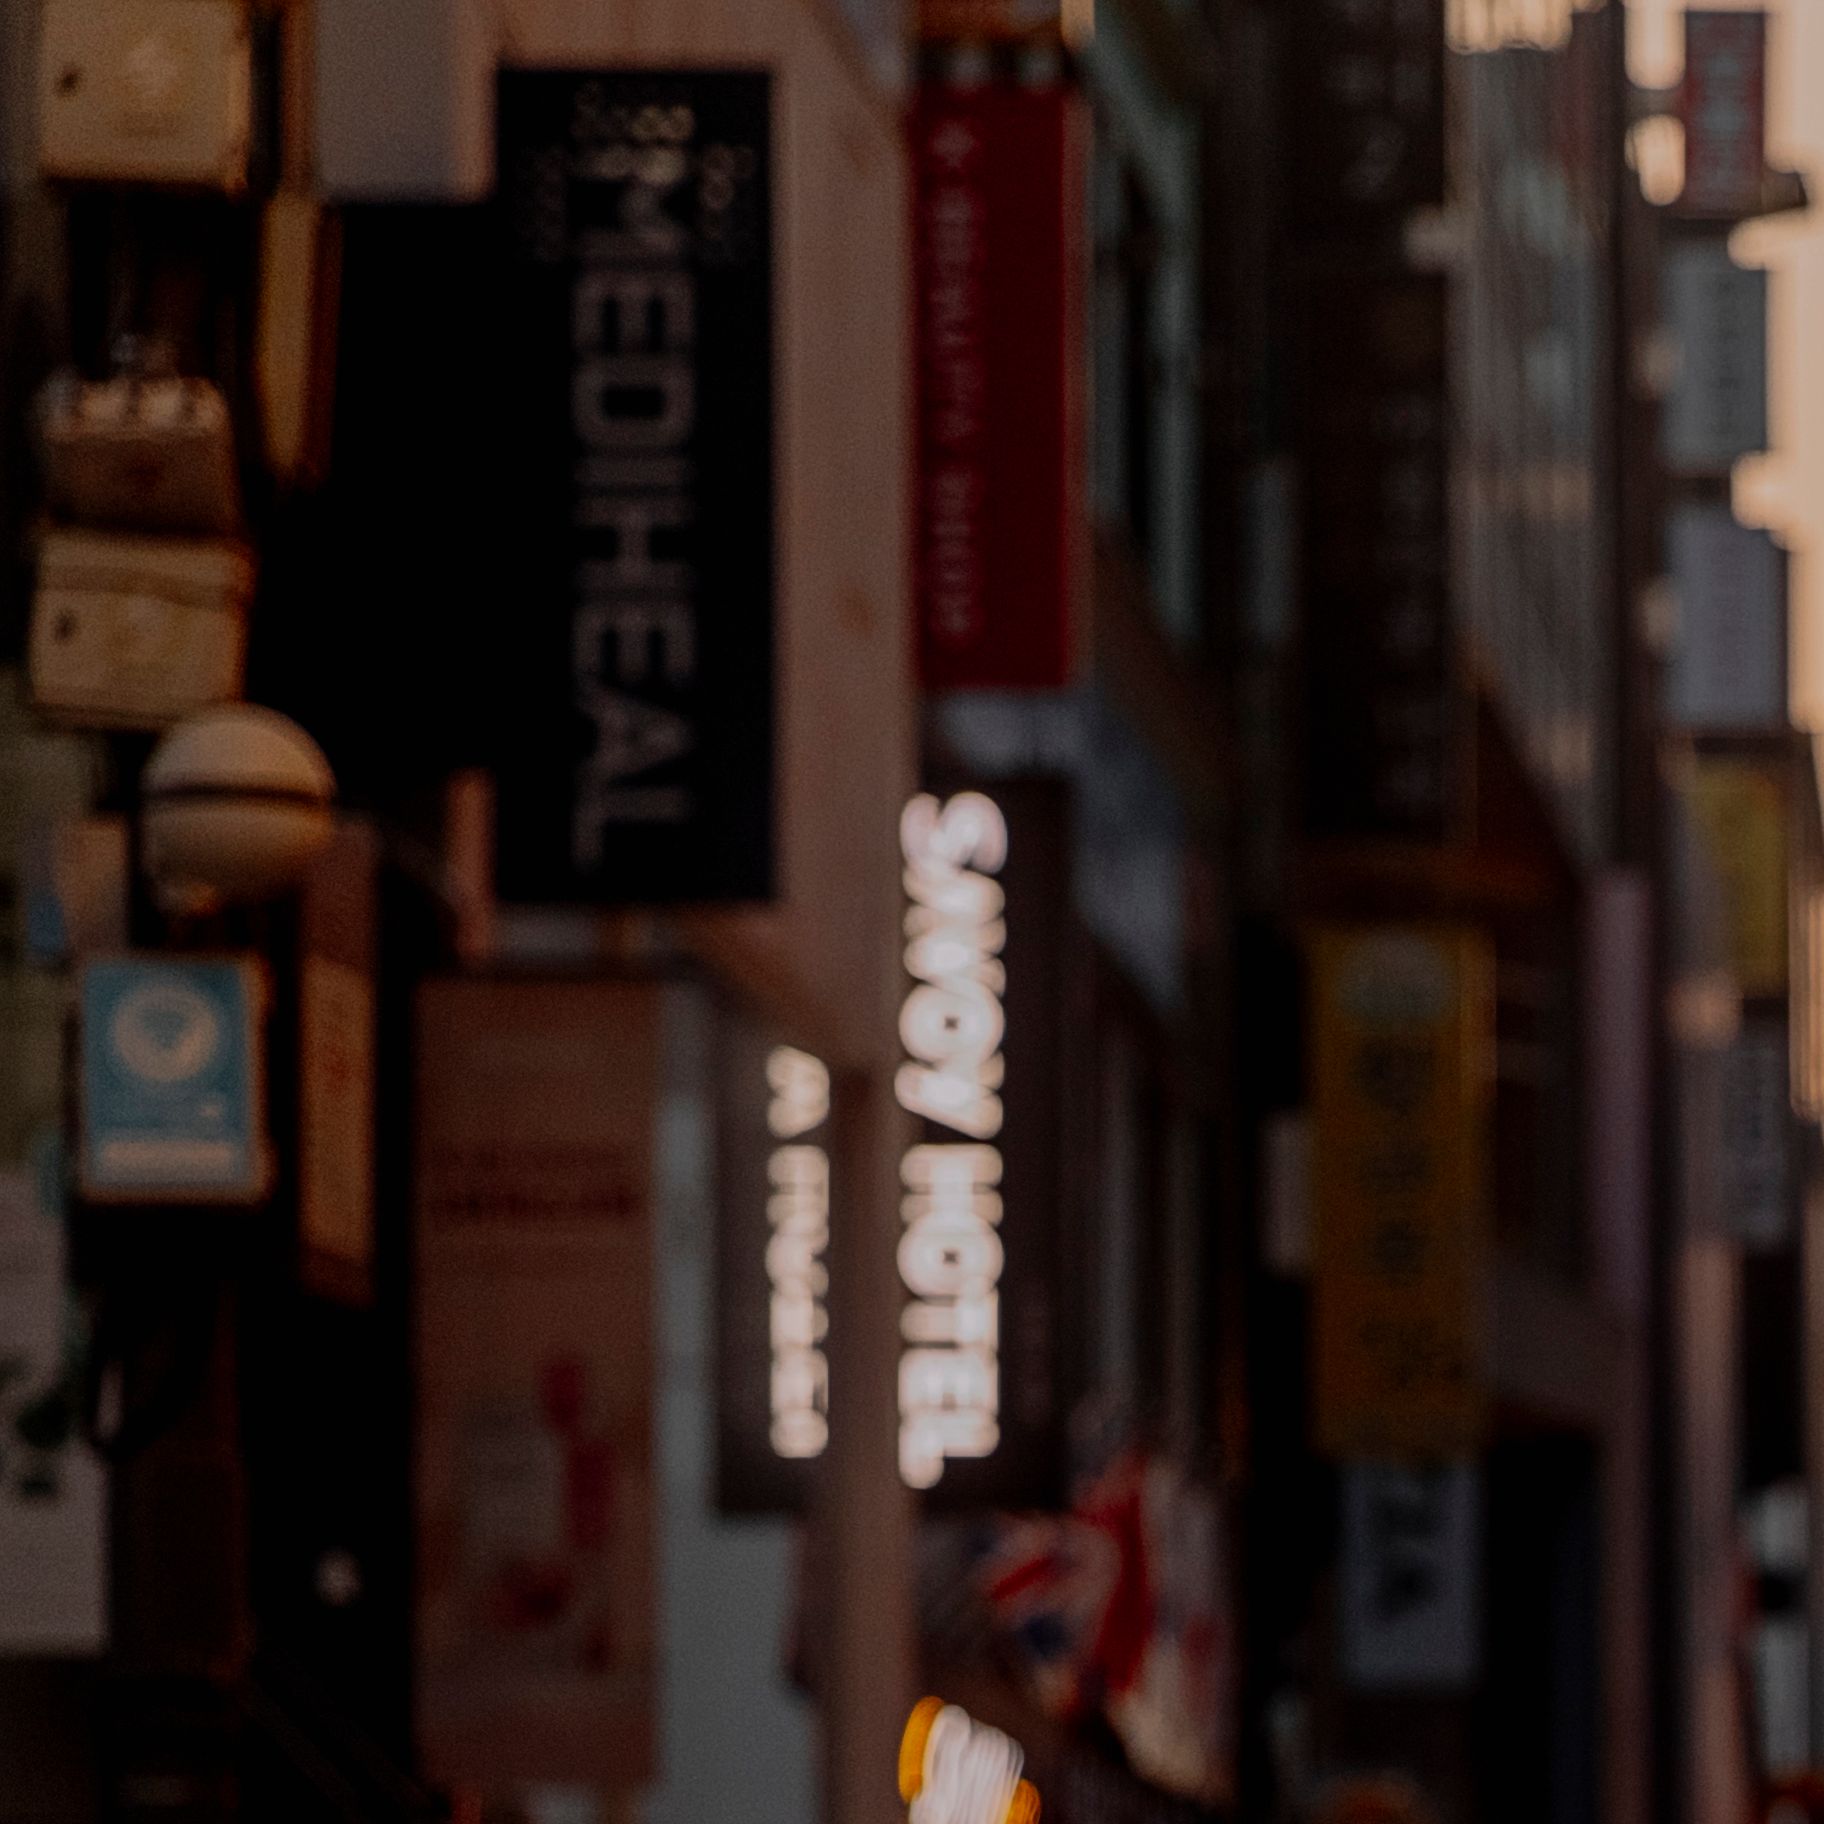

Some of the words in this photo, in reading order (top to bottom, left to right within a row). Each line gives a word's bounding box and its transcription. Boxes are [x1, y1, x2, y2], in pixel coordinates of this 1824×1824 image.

[567, 146, 703, 876] MEDIHEAL
[895, 790, 1009, 1139] SAVOY
[896, 1142, 1005, 1489] HOTEL
